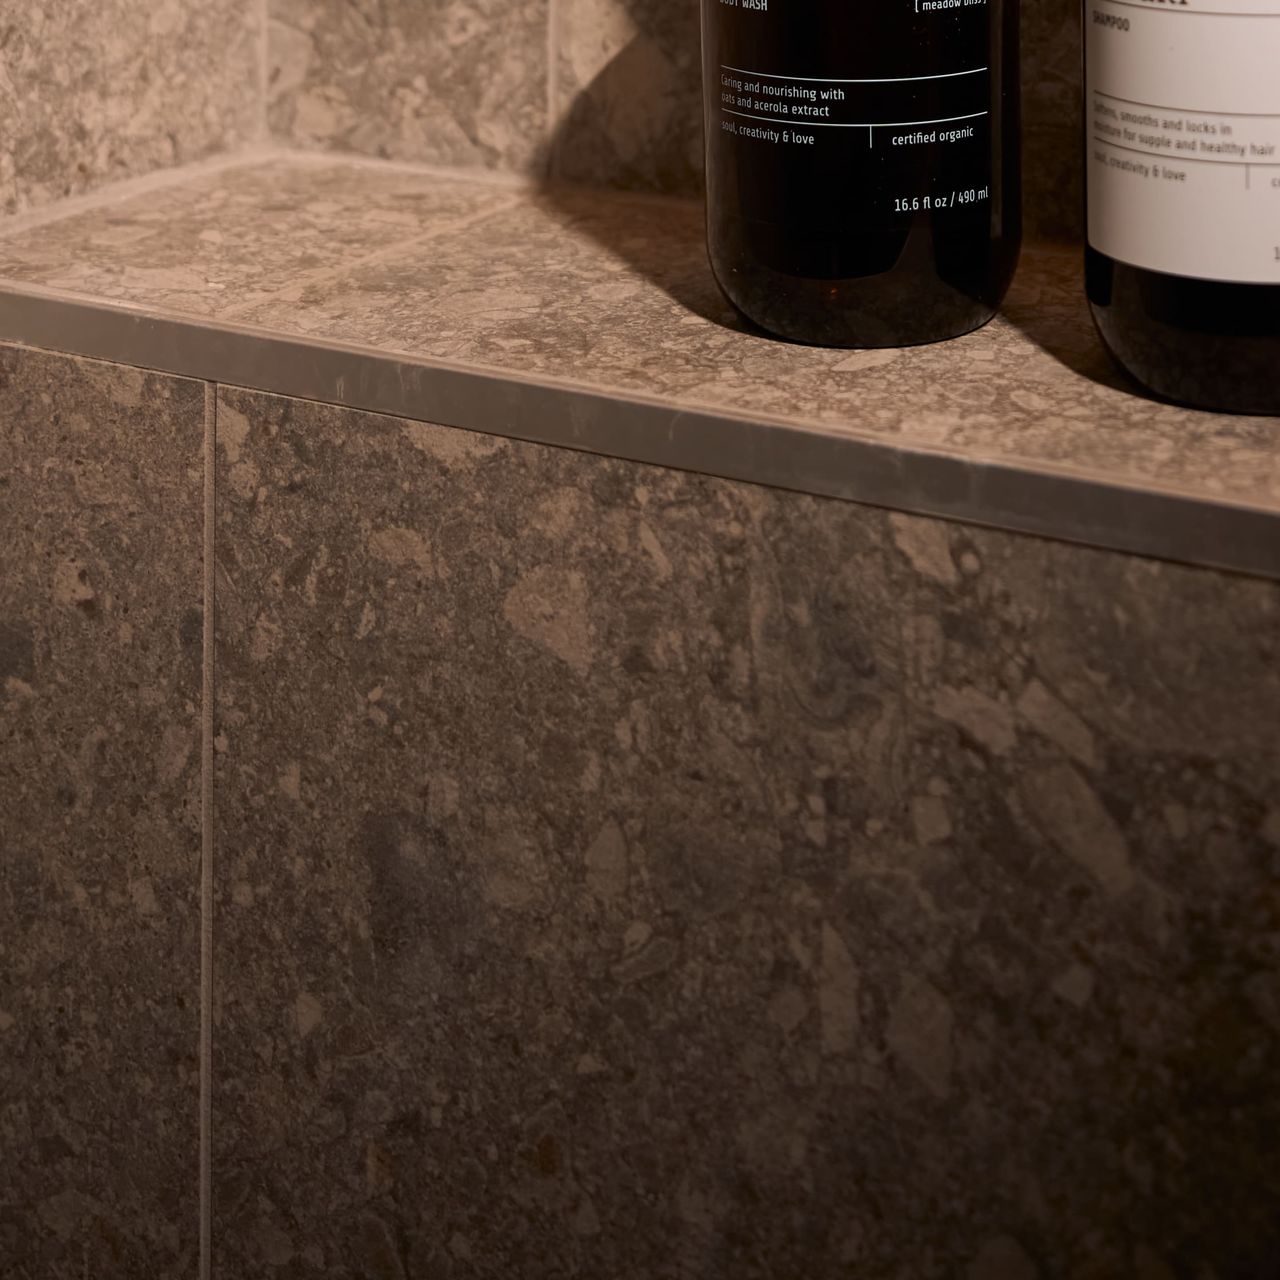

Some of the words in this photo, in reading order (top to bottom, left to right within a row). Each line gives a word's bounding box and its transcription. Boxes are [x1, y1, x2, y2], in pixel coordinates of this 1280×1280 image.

[721, 74, 742, 92] Caring
[745, 82, 759, 93] and
[763, 85, 817, 101] nourishing
[820, 88, 845, 100] with
[721, 93, 735, 104] oats
[737, 97, 752, 108] and
[754, 100, 788, 114] acerola
[792, 105, 829, 117] extract
[739, 125, 779, 143] creativity
[782, 130, 789, 143] &
[792, 131, 815, 145] love
[892, 130, 936, 145] certified
[939, 126, 974, 143] organic
[1162, 119, 1182, 131] and
[1220, 121, 1232, 135] in
[1175, 139, 1196, 151] and
[1200, 139, 1245, 157] healthy
[1250, 142, 1275, 156] hair
[1162, 166, 1186, 181] love
[894, 197, 919, 211] 16.6
[923, 196, 931, 209] fl
[935, 197, 947, 208] oz
[958, 189, 975, 204] 490
[978, 185, 988, 200] ml
